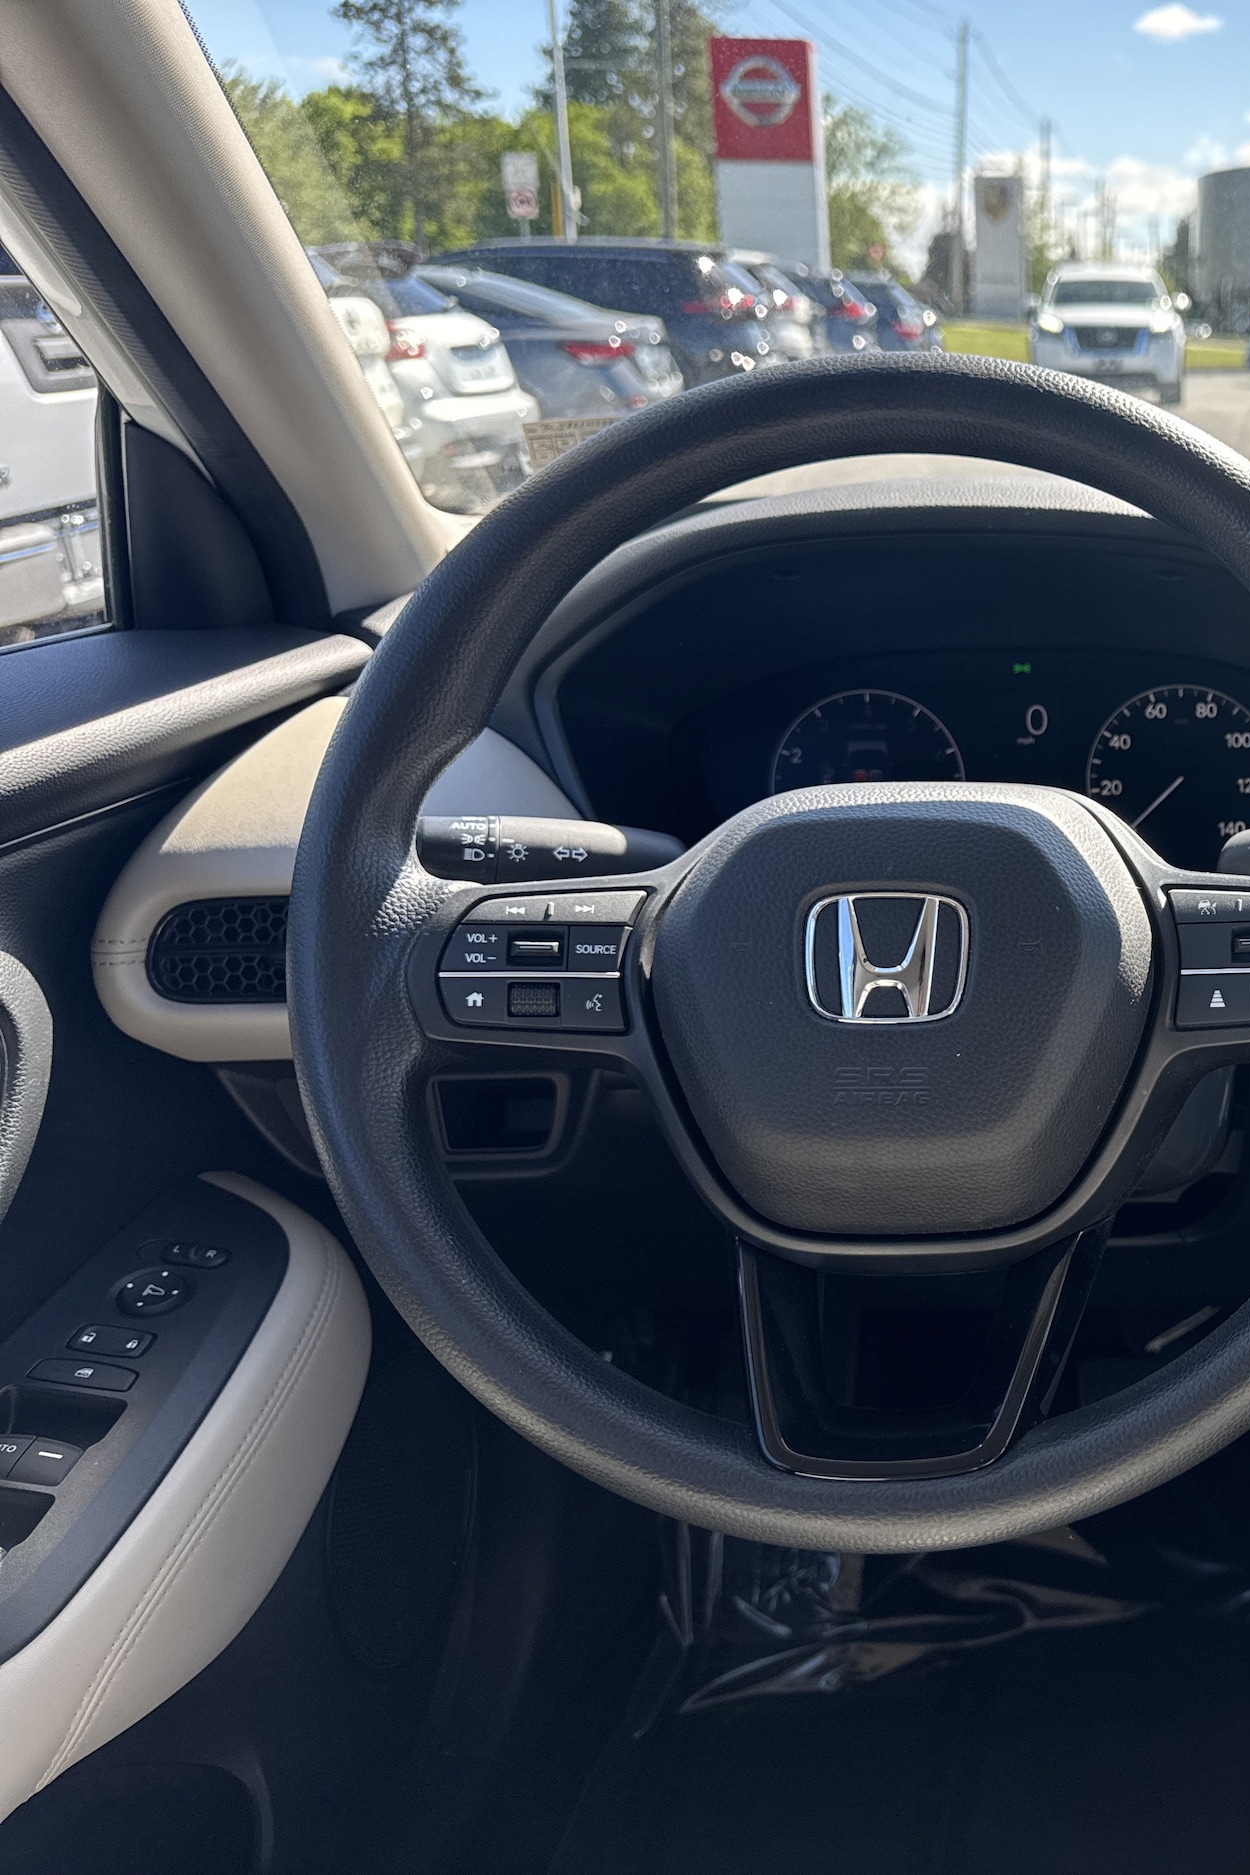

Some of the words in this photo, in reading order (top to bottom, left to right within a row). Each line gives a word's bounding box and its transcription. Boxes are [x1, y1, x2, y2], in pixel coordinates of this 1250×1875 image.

[1144, 702, 1168, 720] 60
[1195, 702, 1218, 719] 80
[1025, 703, 1048, 736] 0
[1108, 733, 1132, 750] 40
[790, 747, 803, 764] 2
[1100, 780, 1123, 796] 20
[450, 821, 486, 831] AUTO
[1217, 821, 1247, 837] 140
[575, 944, 617, 956] SOURCE
[0, 1443, 17, 1453] TO
